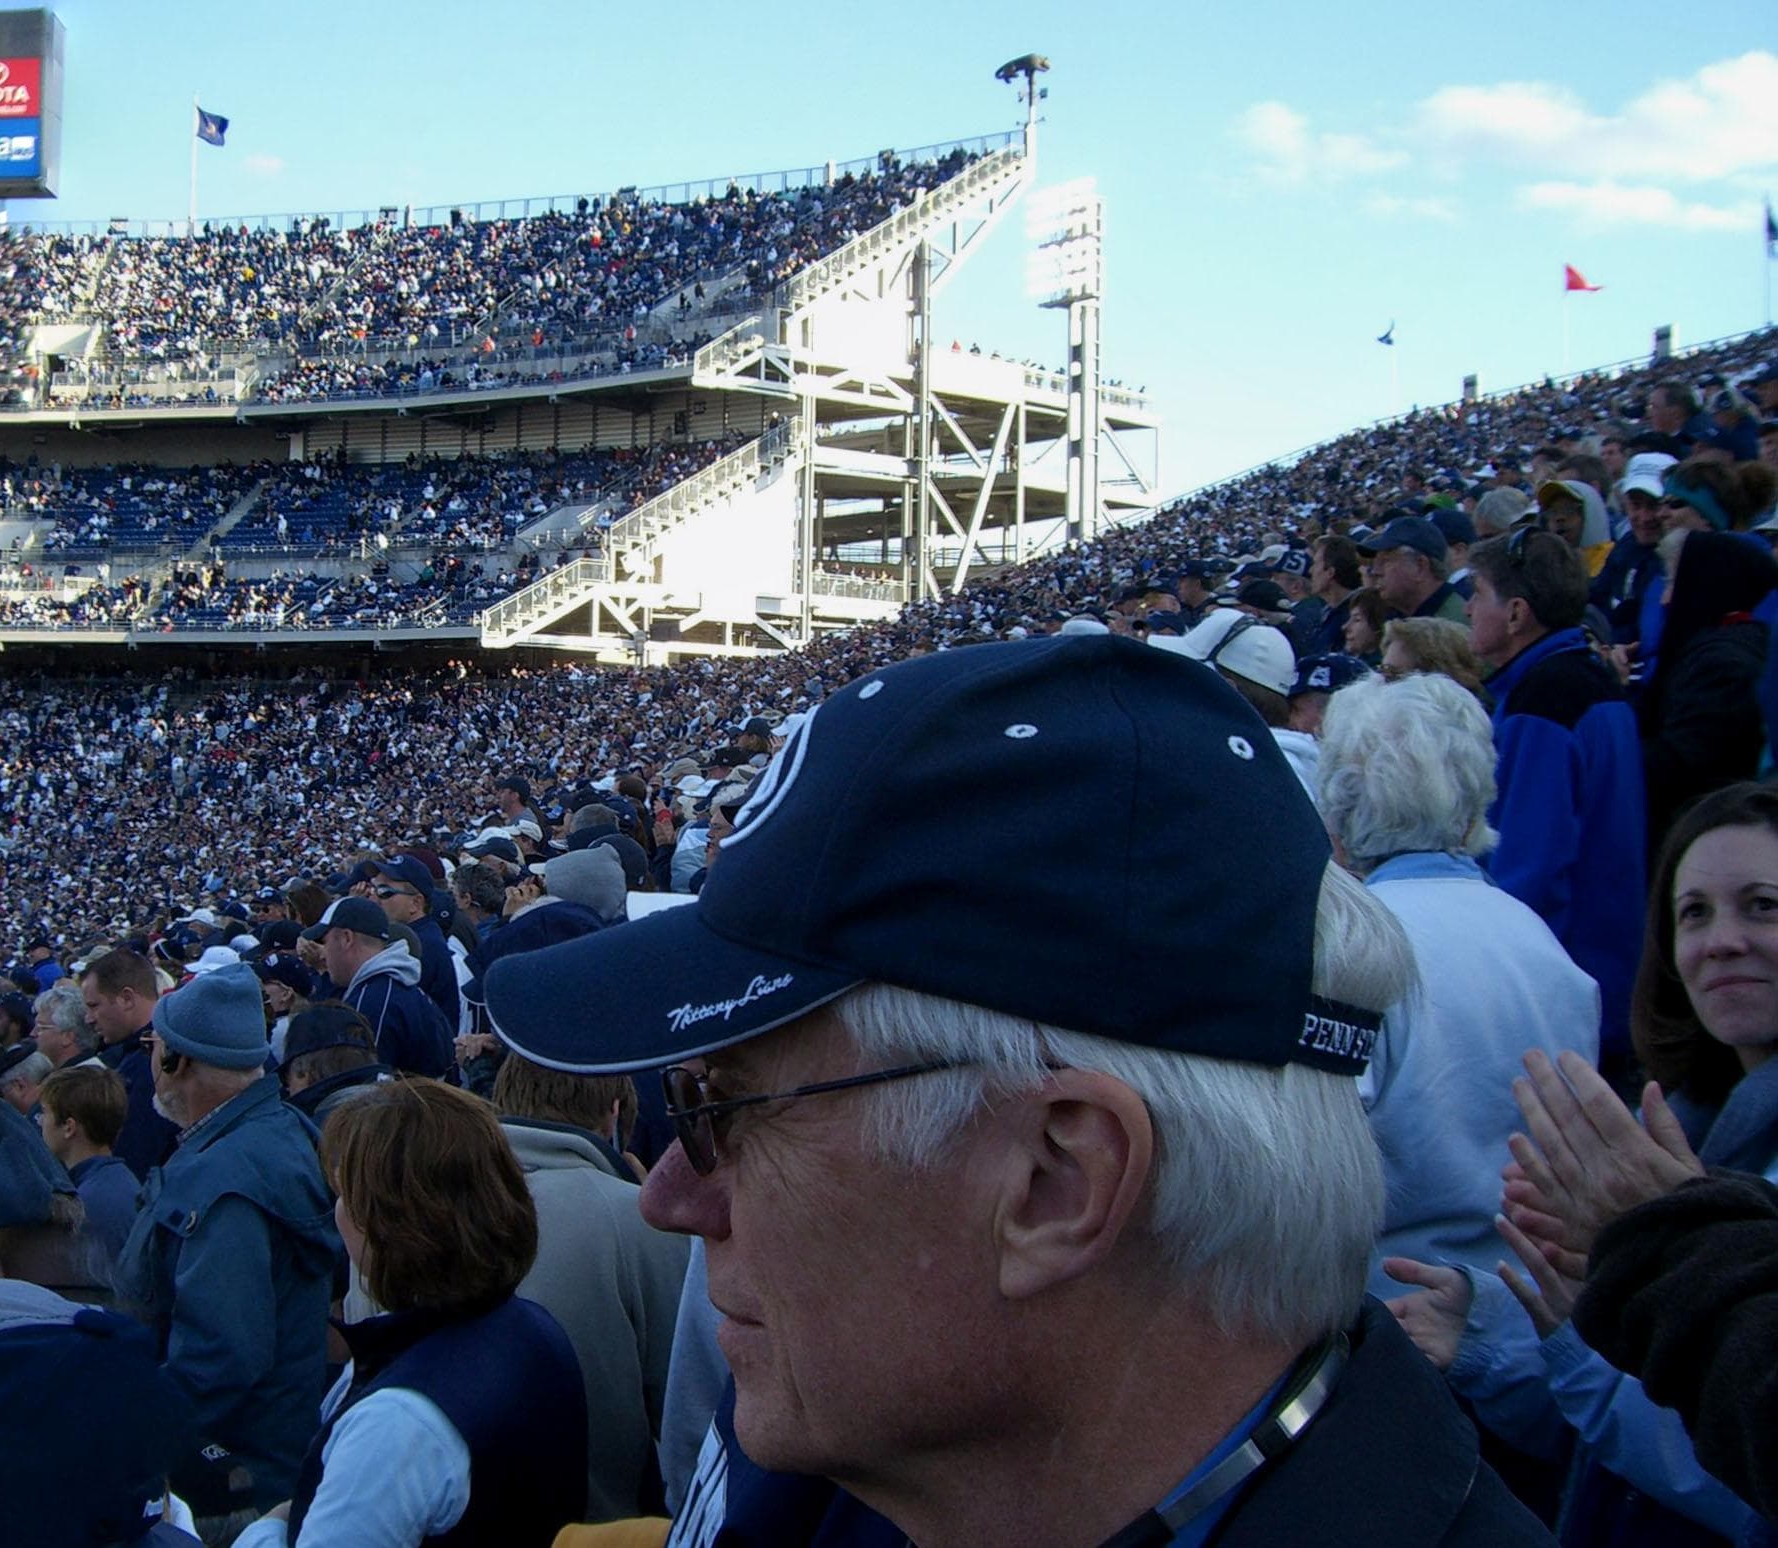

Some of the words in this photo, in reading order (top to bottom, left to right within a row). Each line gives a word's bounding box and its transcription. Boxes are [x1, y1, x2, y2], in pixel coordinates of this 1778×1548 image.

[667, 1000, 738, 1032] Nittany
[738, 973, 794, 1007] Lions
[1298, 1013, 1358, 1056] PENN
